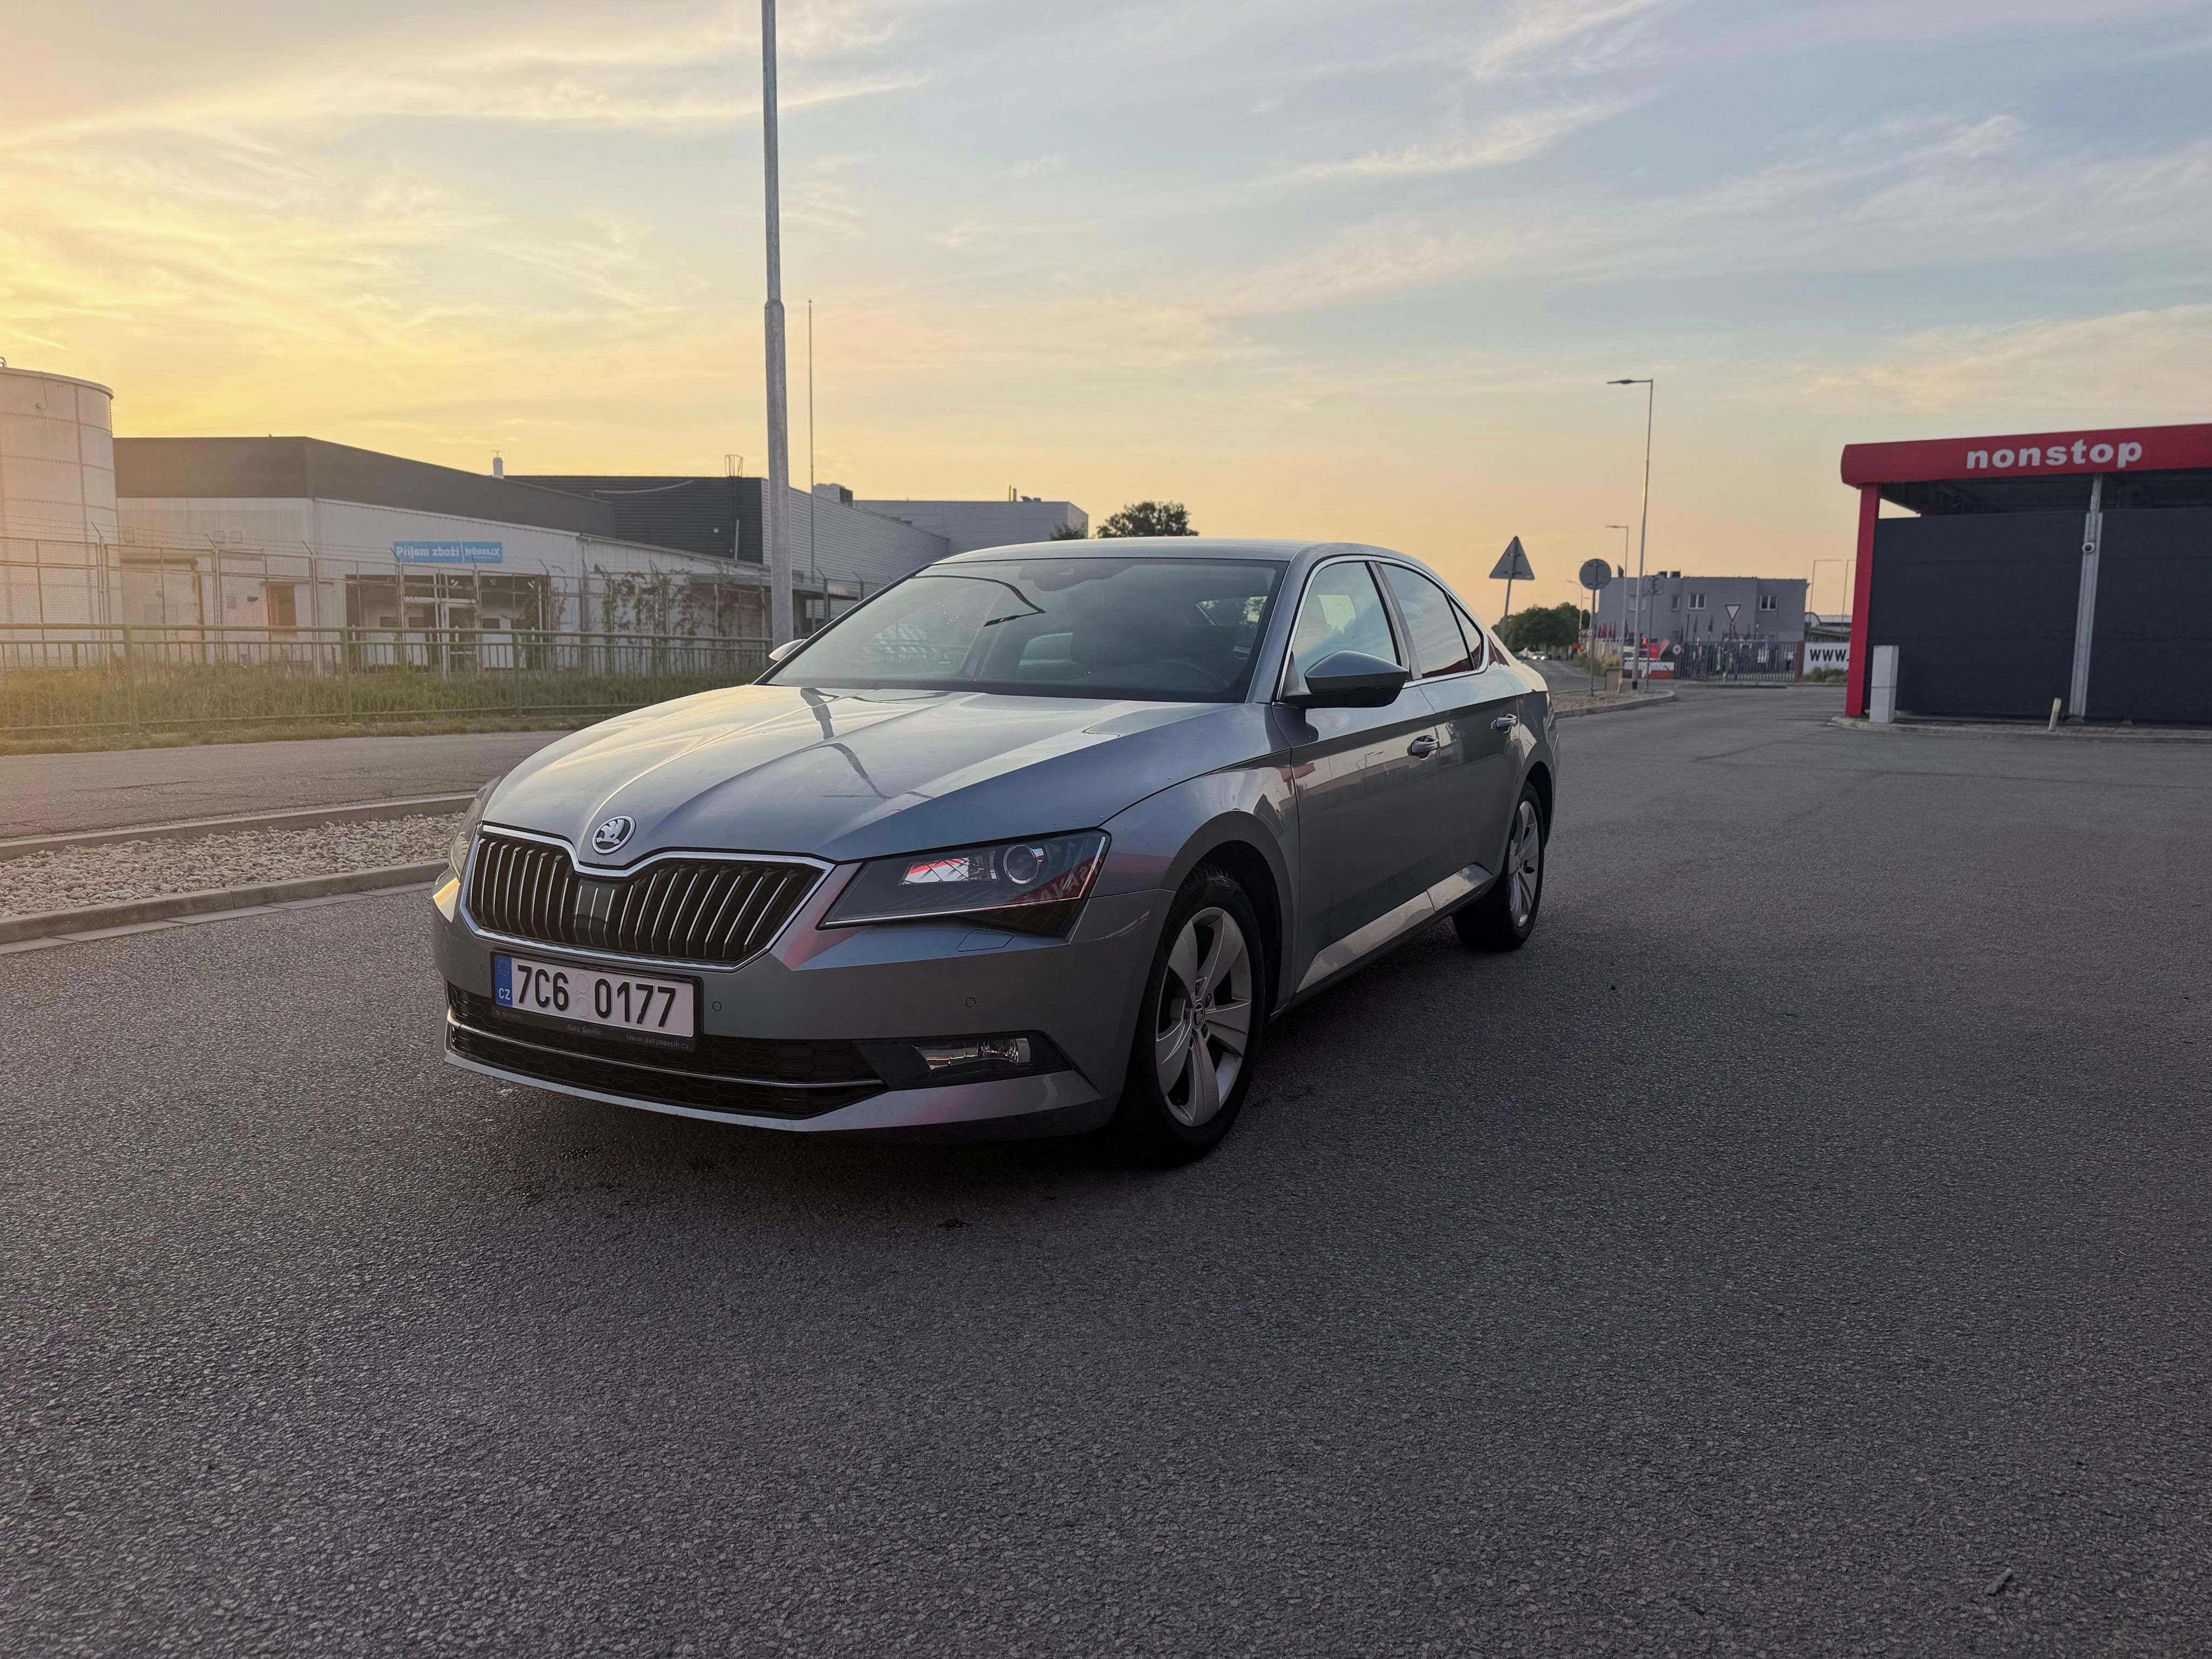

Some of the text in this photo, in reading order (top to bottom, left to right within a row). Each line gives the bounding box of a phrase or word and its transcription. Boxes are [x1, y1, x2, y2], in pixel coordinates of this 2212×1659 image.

[1966, 439, 2142, 469] nonstop
[499, 988, 510, 1000] CZ
[517, 965, 676, 1027] 7C6 0177
